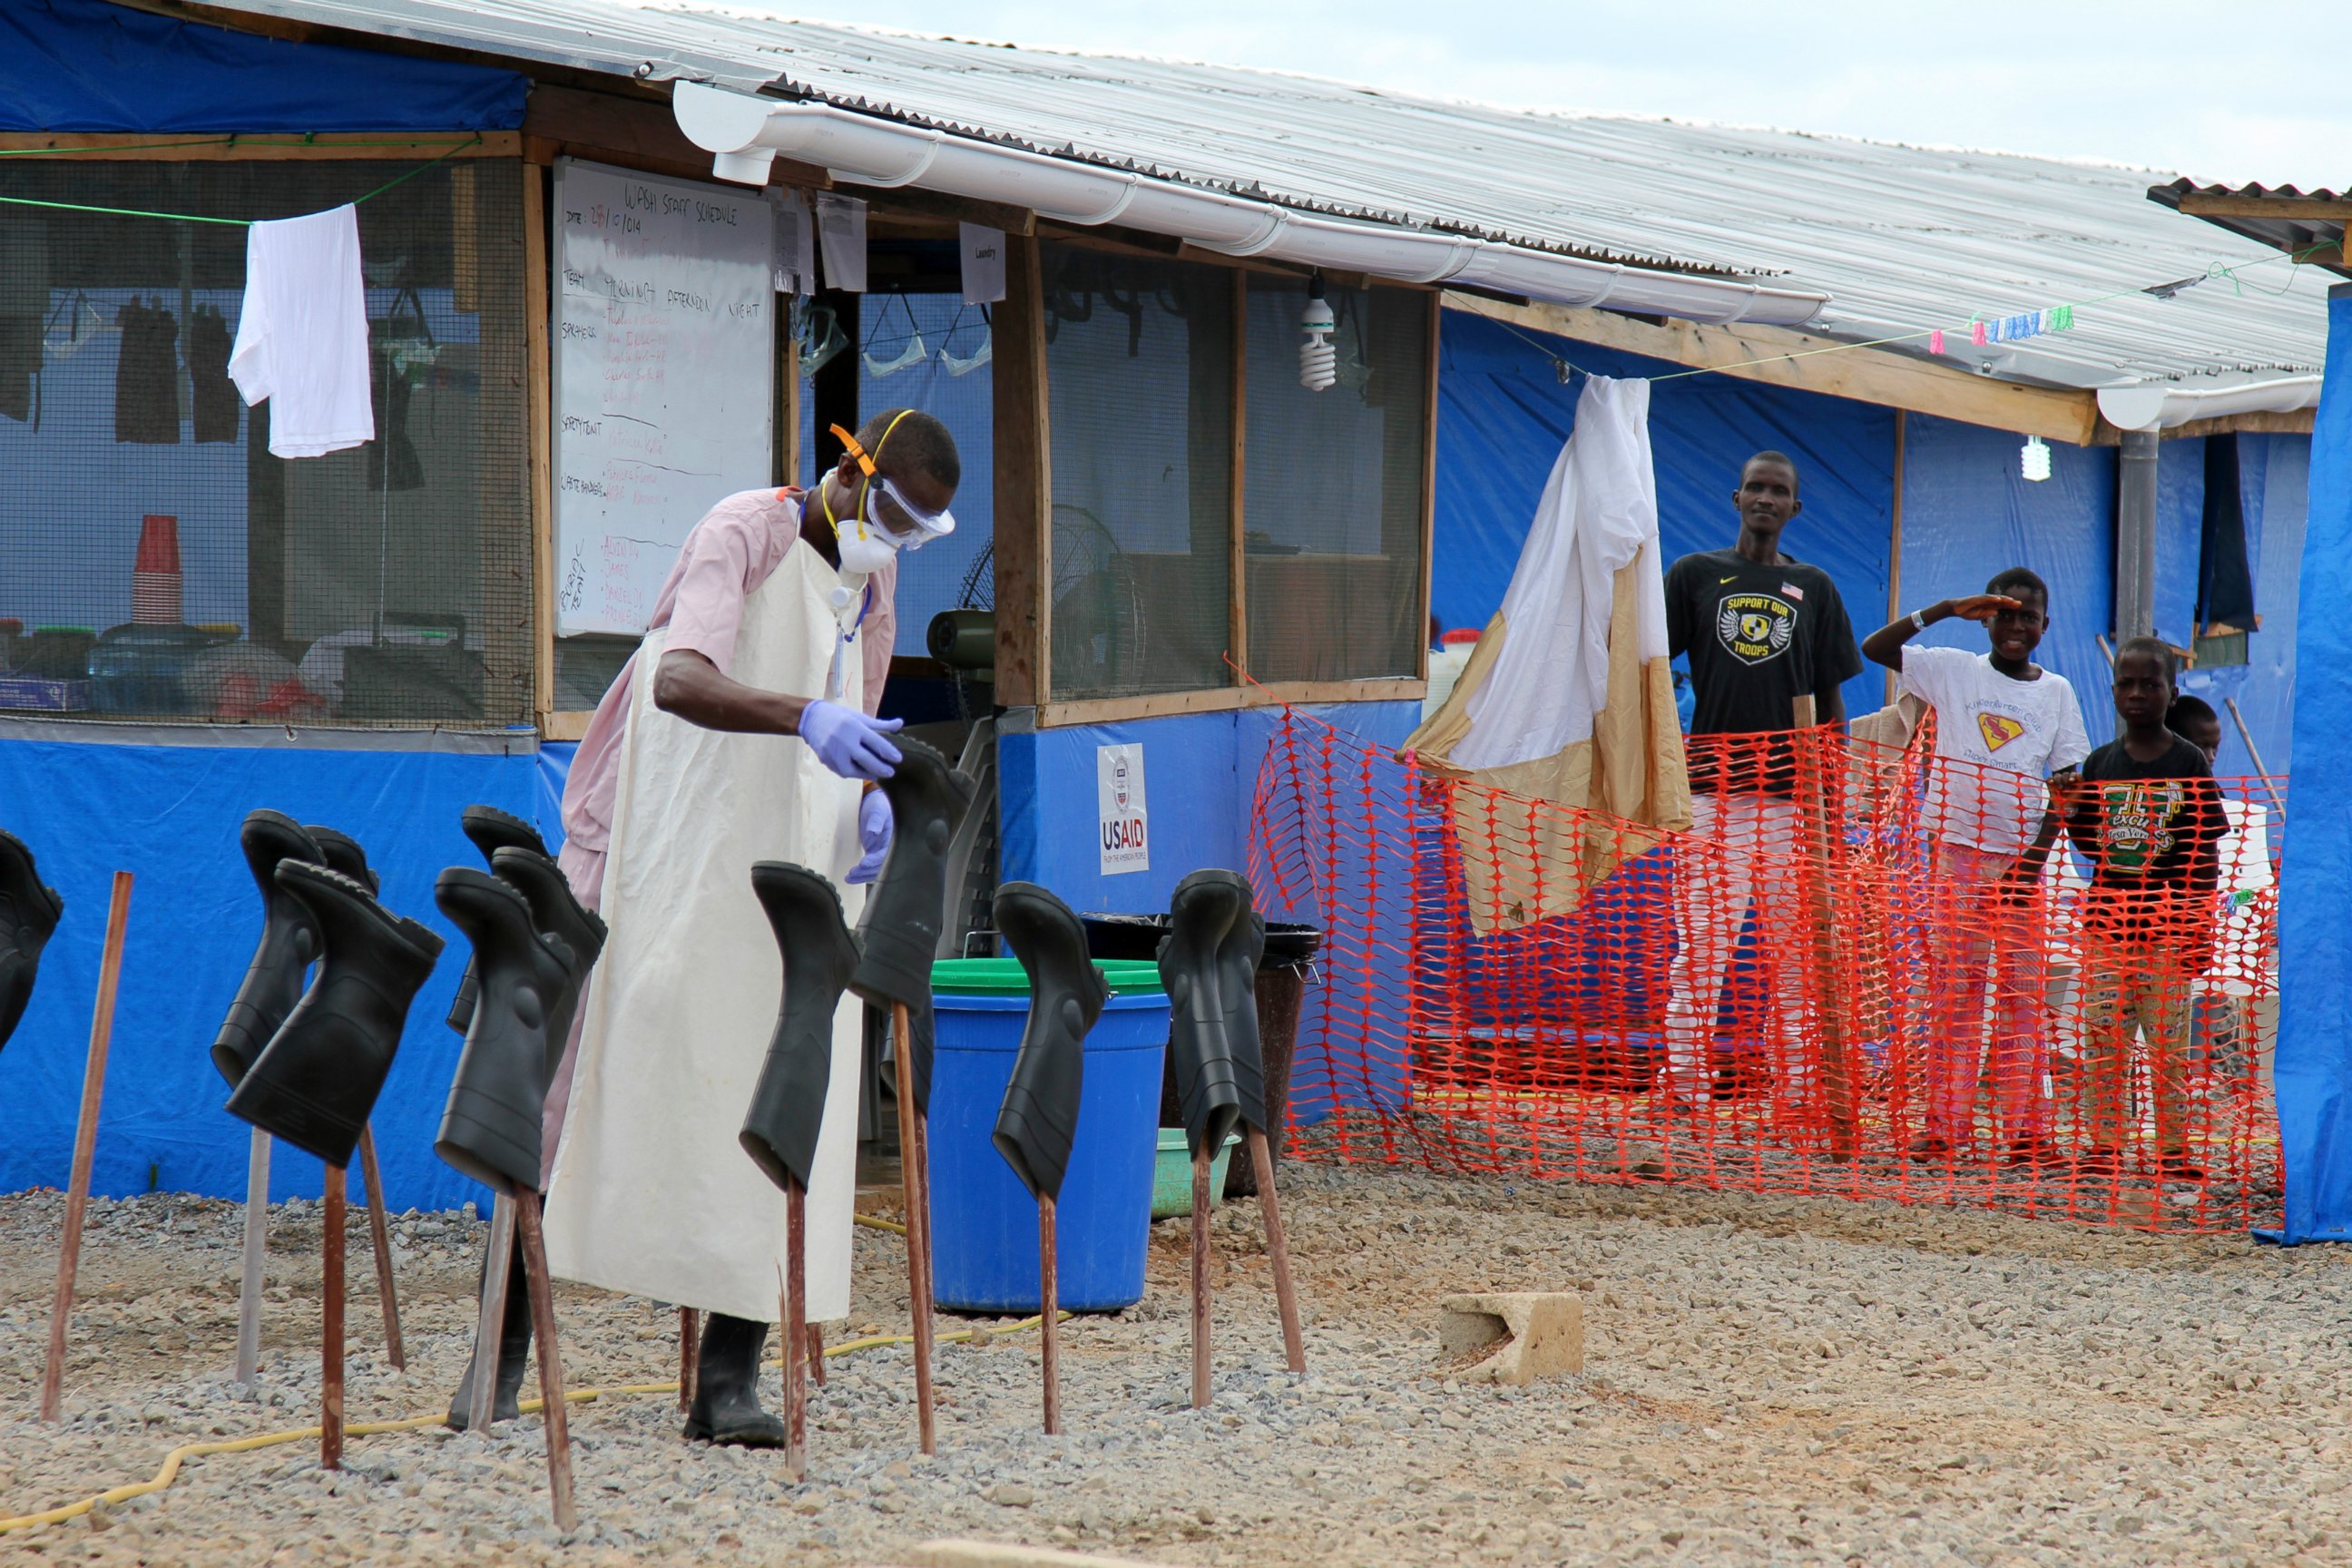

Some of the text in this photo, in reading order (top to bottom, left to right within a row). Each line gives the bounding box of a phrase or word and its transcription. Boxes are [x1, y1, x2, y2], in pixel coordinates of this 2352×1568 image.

[624, 181, 657, 214] WASH
[695, 201, 738, 227] SCHEDULE
[975, 245, 996, 261] Laundry
[563, 269, 584, 290] TEAM
[728, 302, 760, 319] NIGHT
[603, 558, 630, 582] JAMES
[1728, 597, 1788, 617] SUPPORT OUR
[1734, 641, 1769, 656] TROOPS
[1964, 749, 2018, 769] Super Smart
[1103, 818, 1143, 850] USAID
[2112, 814, 2173, 848] excues
